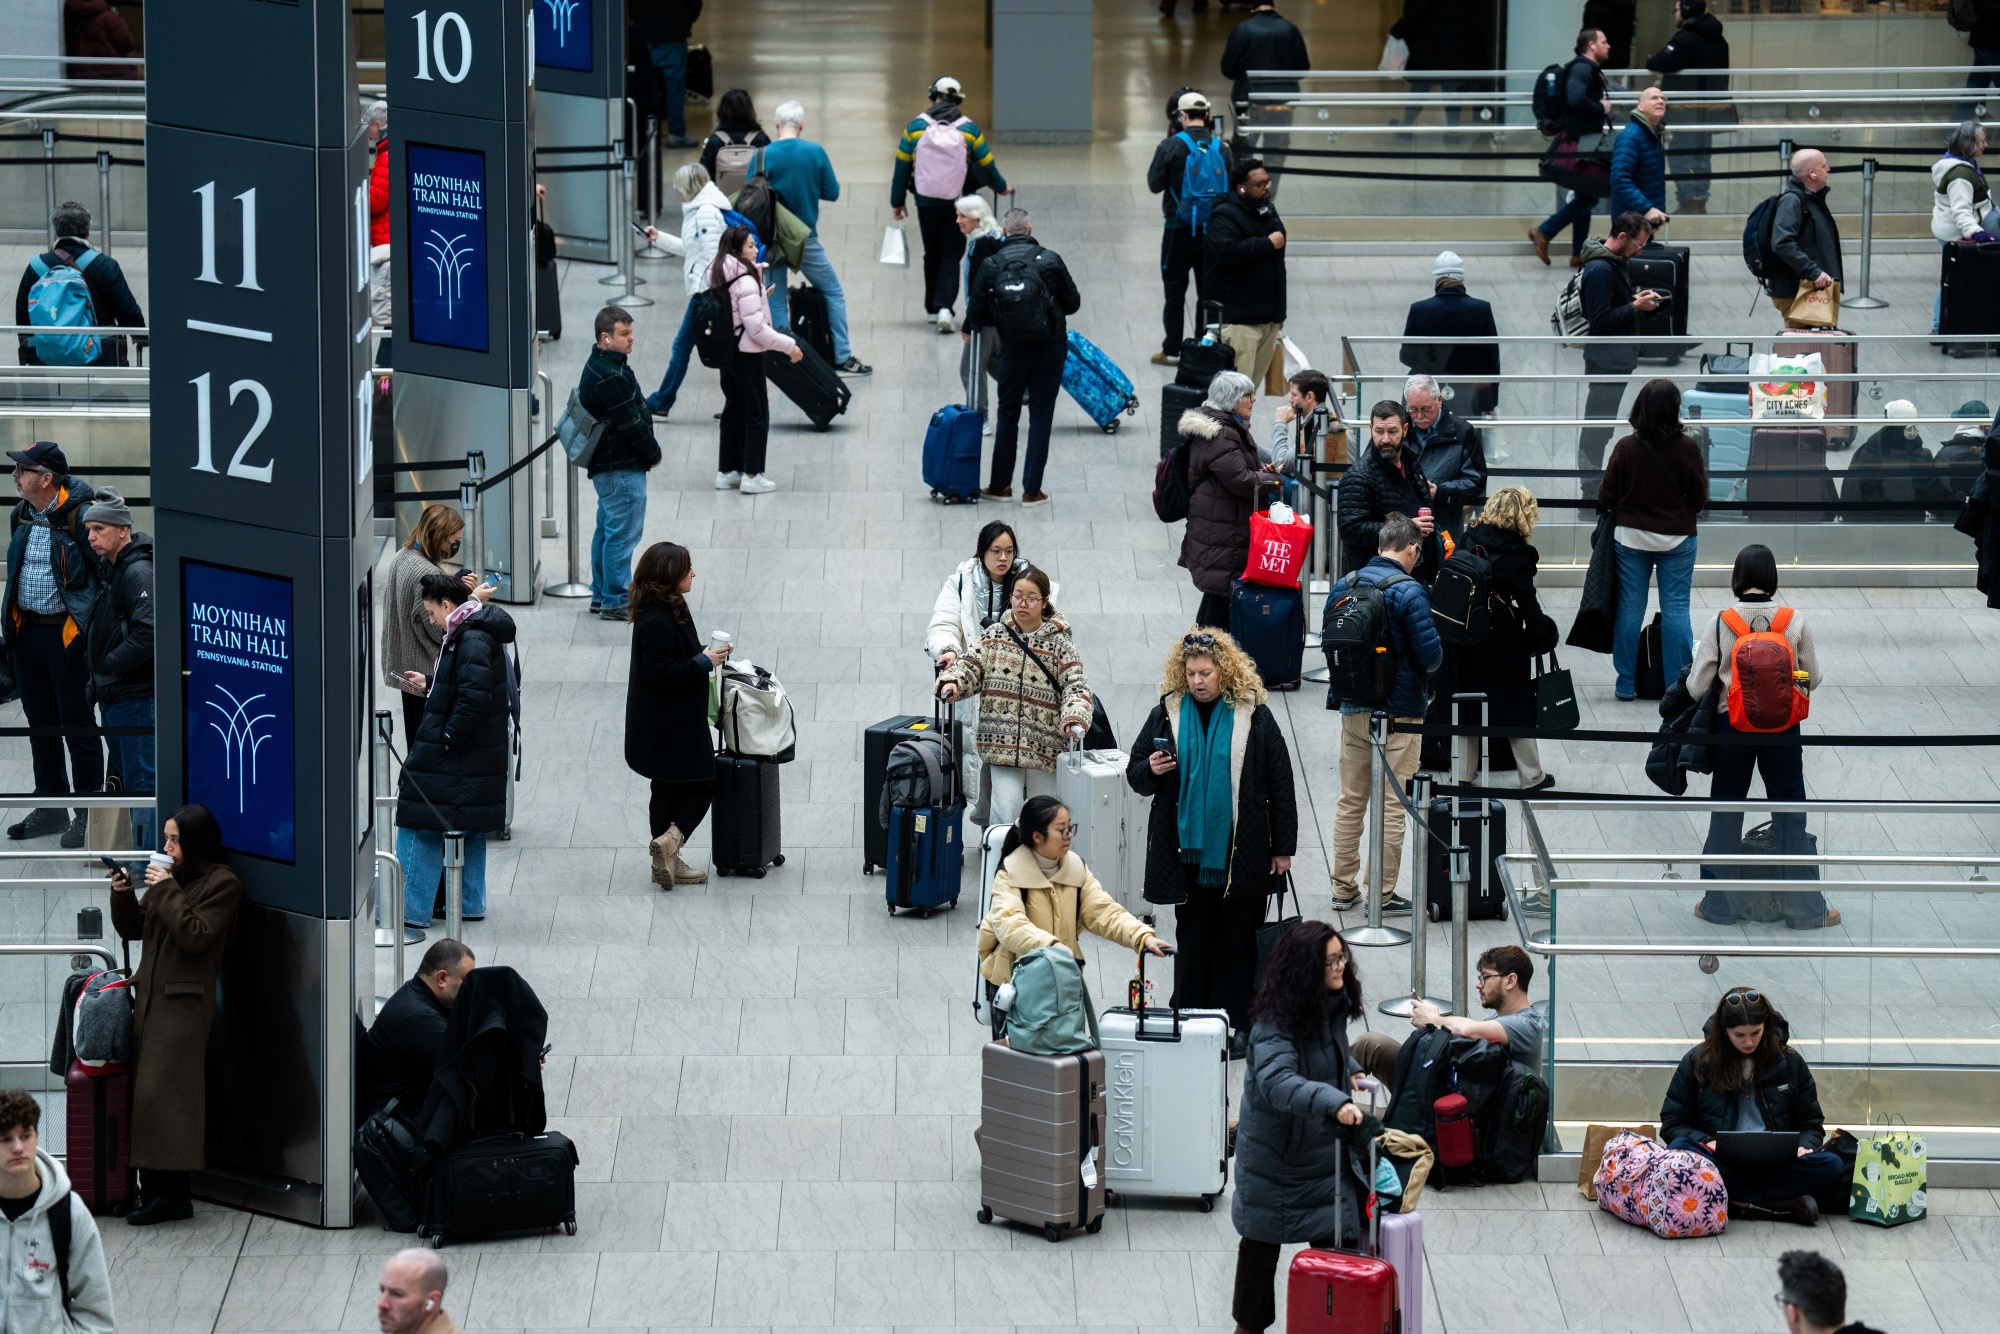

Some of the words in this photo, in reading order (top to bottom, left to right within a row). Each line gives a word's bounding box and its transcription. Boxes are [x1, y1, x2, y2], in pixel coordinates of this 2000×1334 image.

[411, 9, 472, 84] 10
[413, 172, 480, 194] MOYNIHAN
[412, 187, 449, 205] TRAIN
[452, 192, 482, 210] HALL
[417, 205, 455, 217] PENNSYLVANIA
[455, 210, 479, 220] STATION
[193, 181, 265, 292] 11
[1766, 400, 1783, 410] CITY
[1784, 399, 1808, 410] ACRES
[188, 372, 274, 484] 12
[1263, 539, 1292, 559] THE
[1258, 554, 1290, 574] MET
[192, 602, 286, 637] MOYNIHAN
[190, 623, 241, 650] TRAIN
[246, 634, 289, 659] HALL
[197, 649, 250, 668] PENNSYLVANIA
[251, 660, 283, 674] STATION
